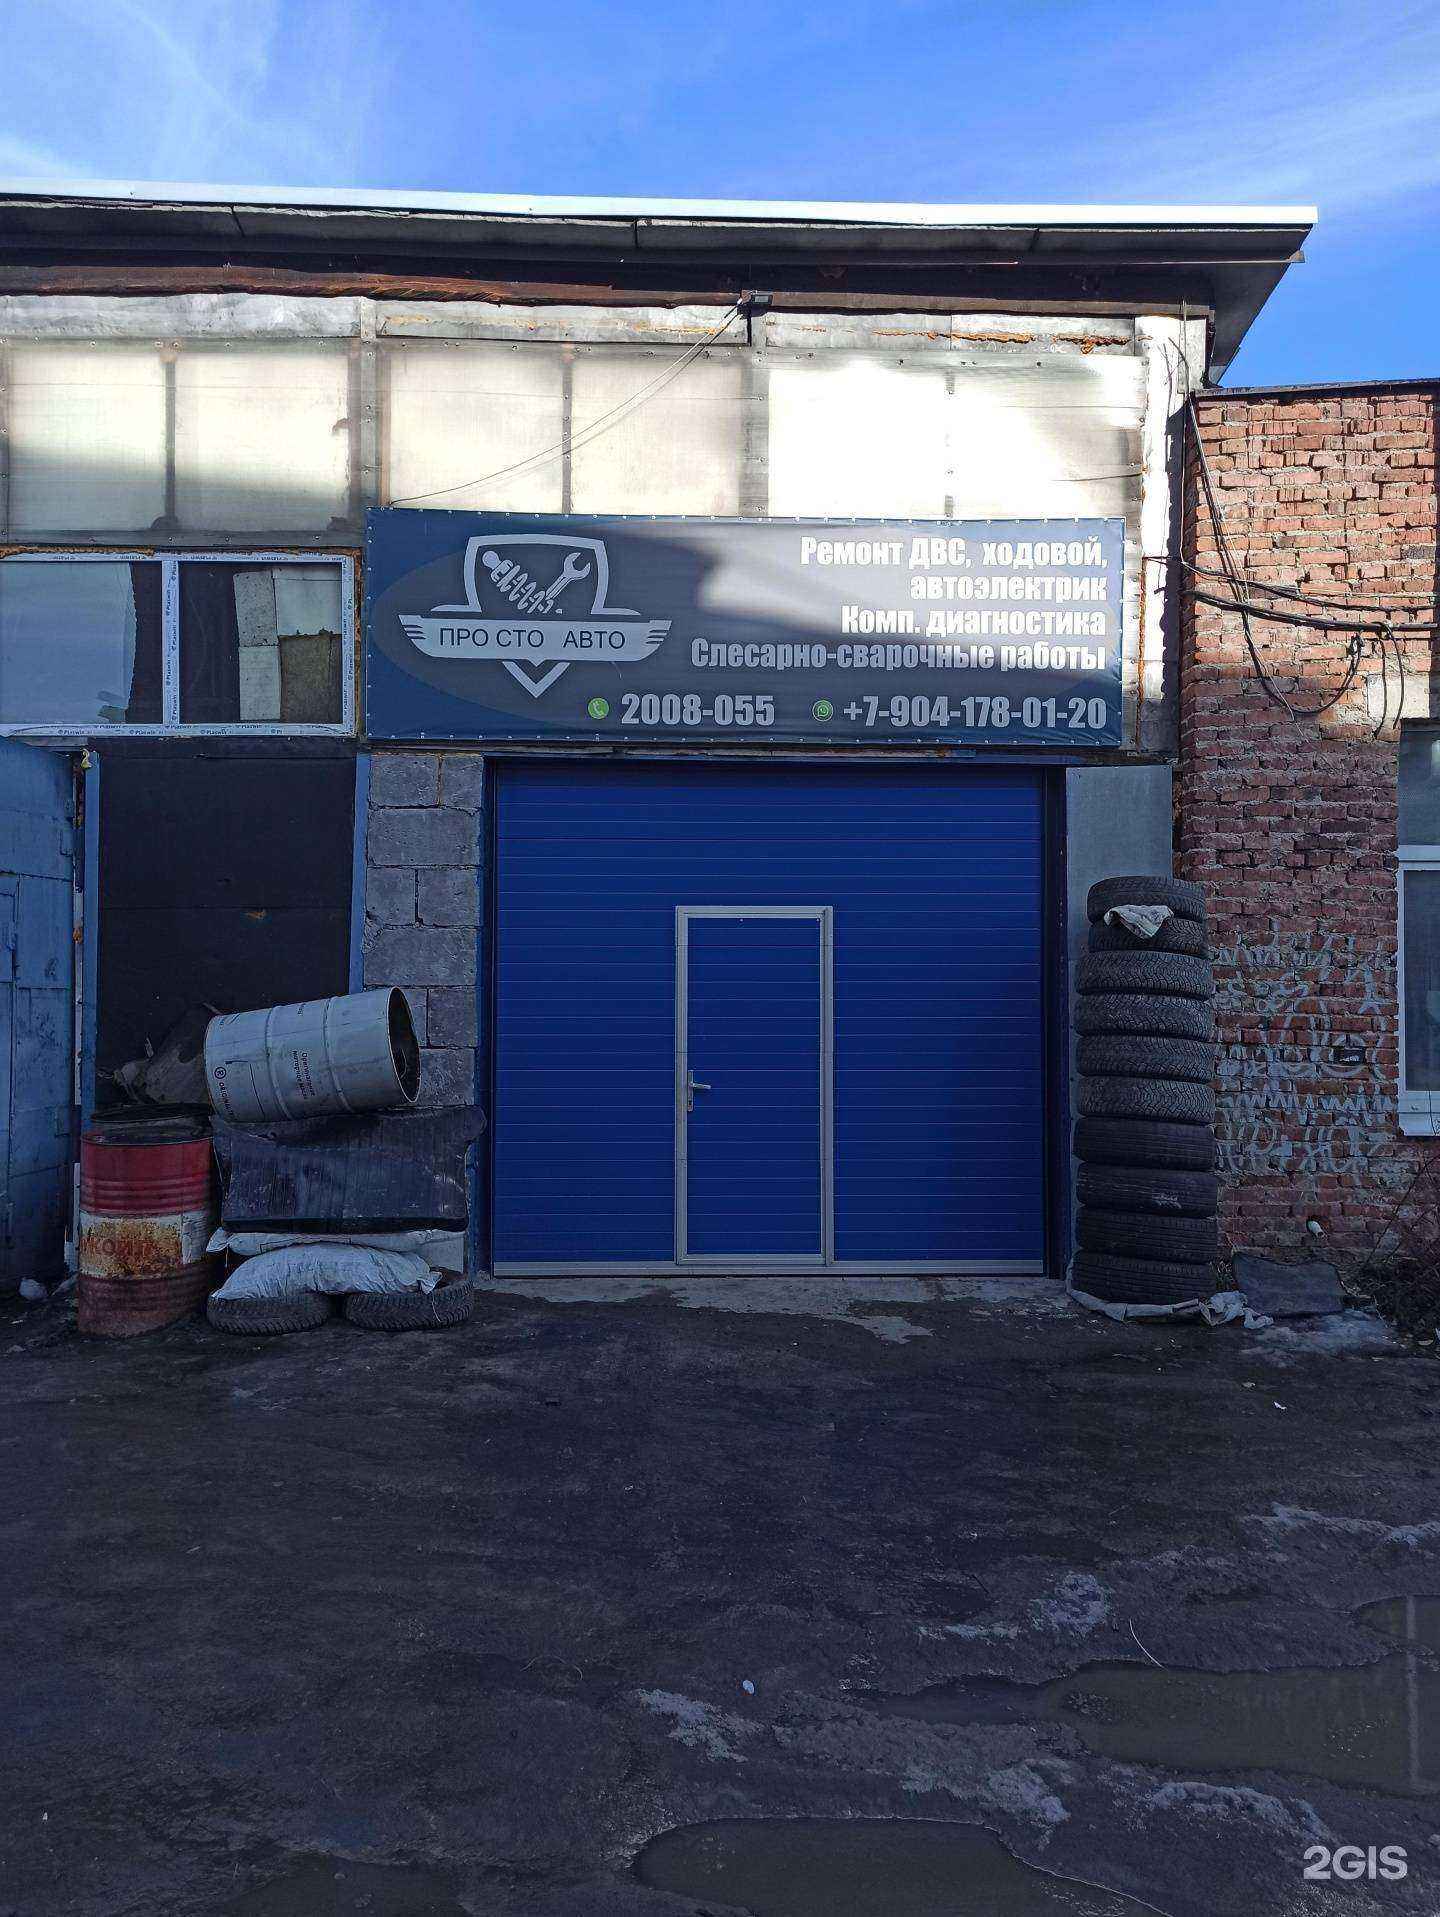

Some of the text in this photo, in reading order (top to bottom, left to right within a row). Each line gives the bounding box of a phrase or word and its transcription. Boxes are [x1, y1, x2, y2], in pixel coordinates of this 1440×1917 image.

[801, 535, 1109, 569] Ремонт ДВС, ходовой,
[910, 575, 1108, 604] автоэлектрик
[841, 604, 1106, 638] Комп. диагностика
[439, 627, 626, 650] ПРО СТО АВТО
[691, 637, 1106, 671] Слесарно-сварочные работы
[621, 693, 775, 726] 2008-055
[843, 695, 1107, 729] +7-904-178-01-20
